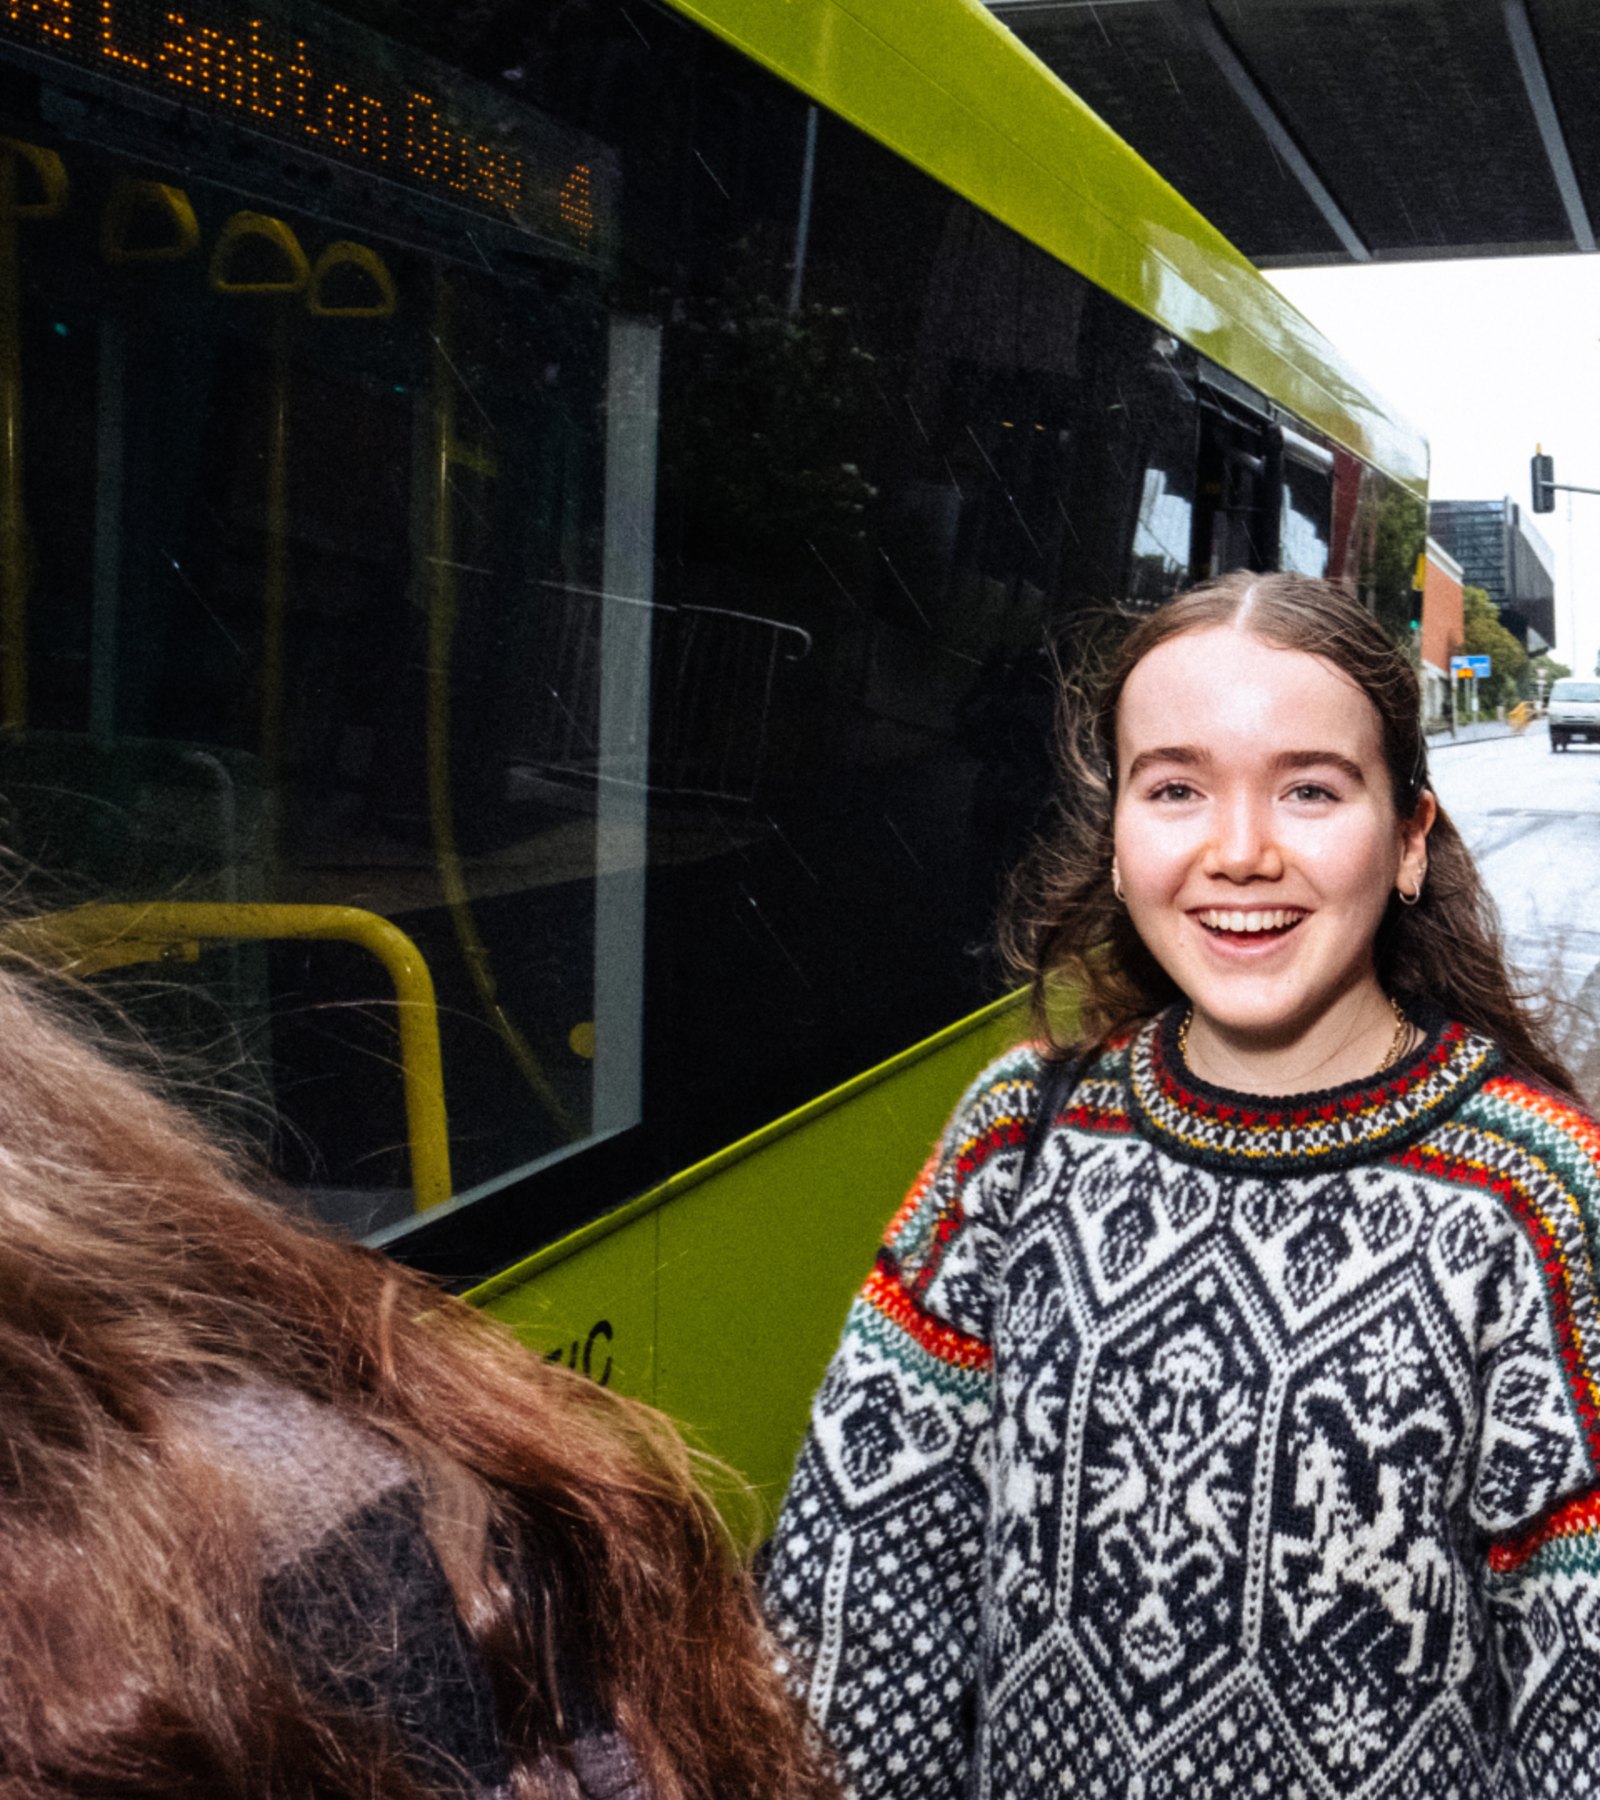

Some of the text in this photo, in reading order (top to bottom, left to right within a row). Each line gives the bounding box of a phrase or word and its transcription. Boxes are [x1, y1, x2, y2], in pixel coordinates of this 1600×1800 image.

[101, 0, 389, 162] Lambton
[406, 92, 523, 211] Quay
[558, 164, 594, 249] 4
